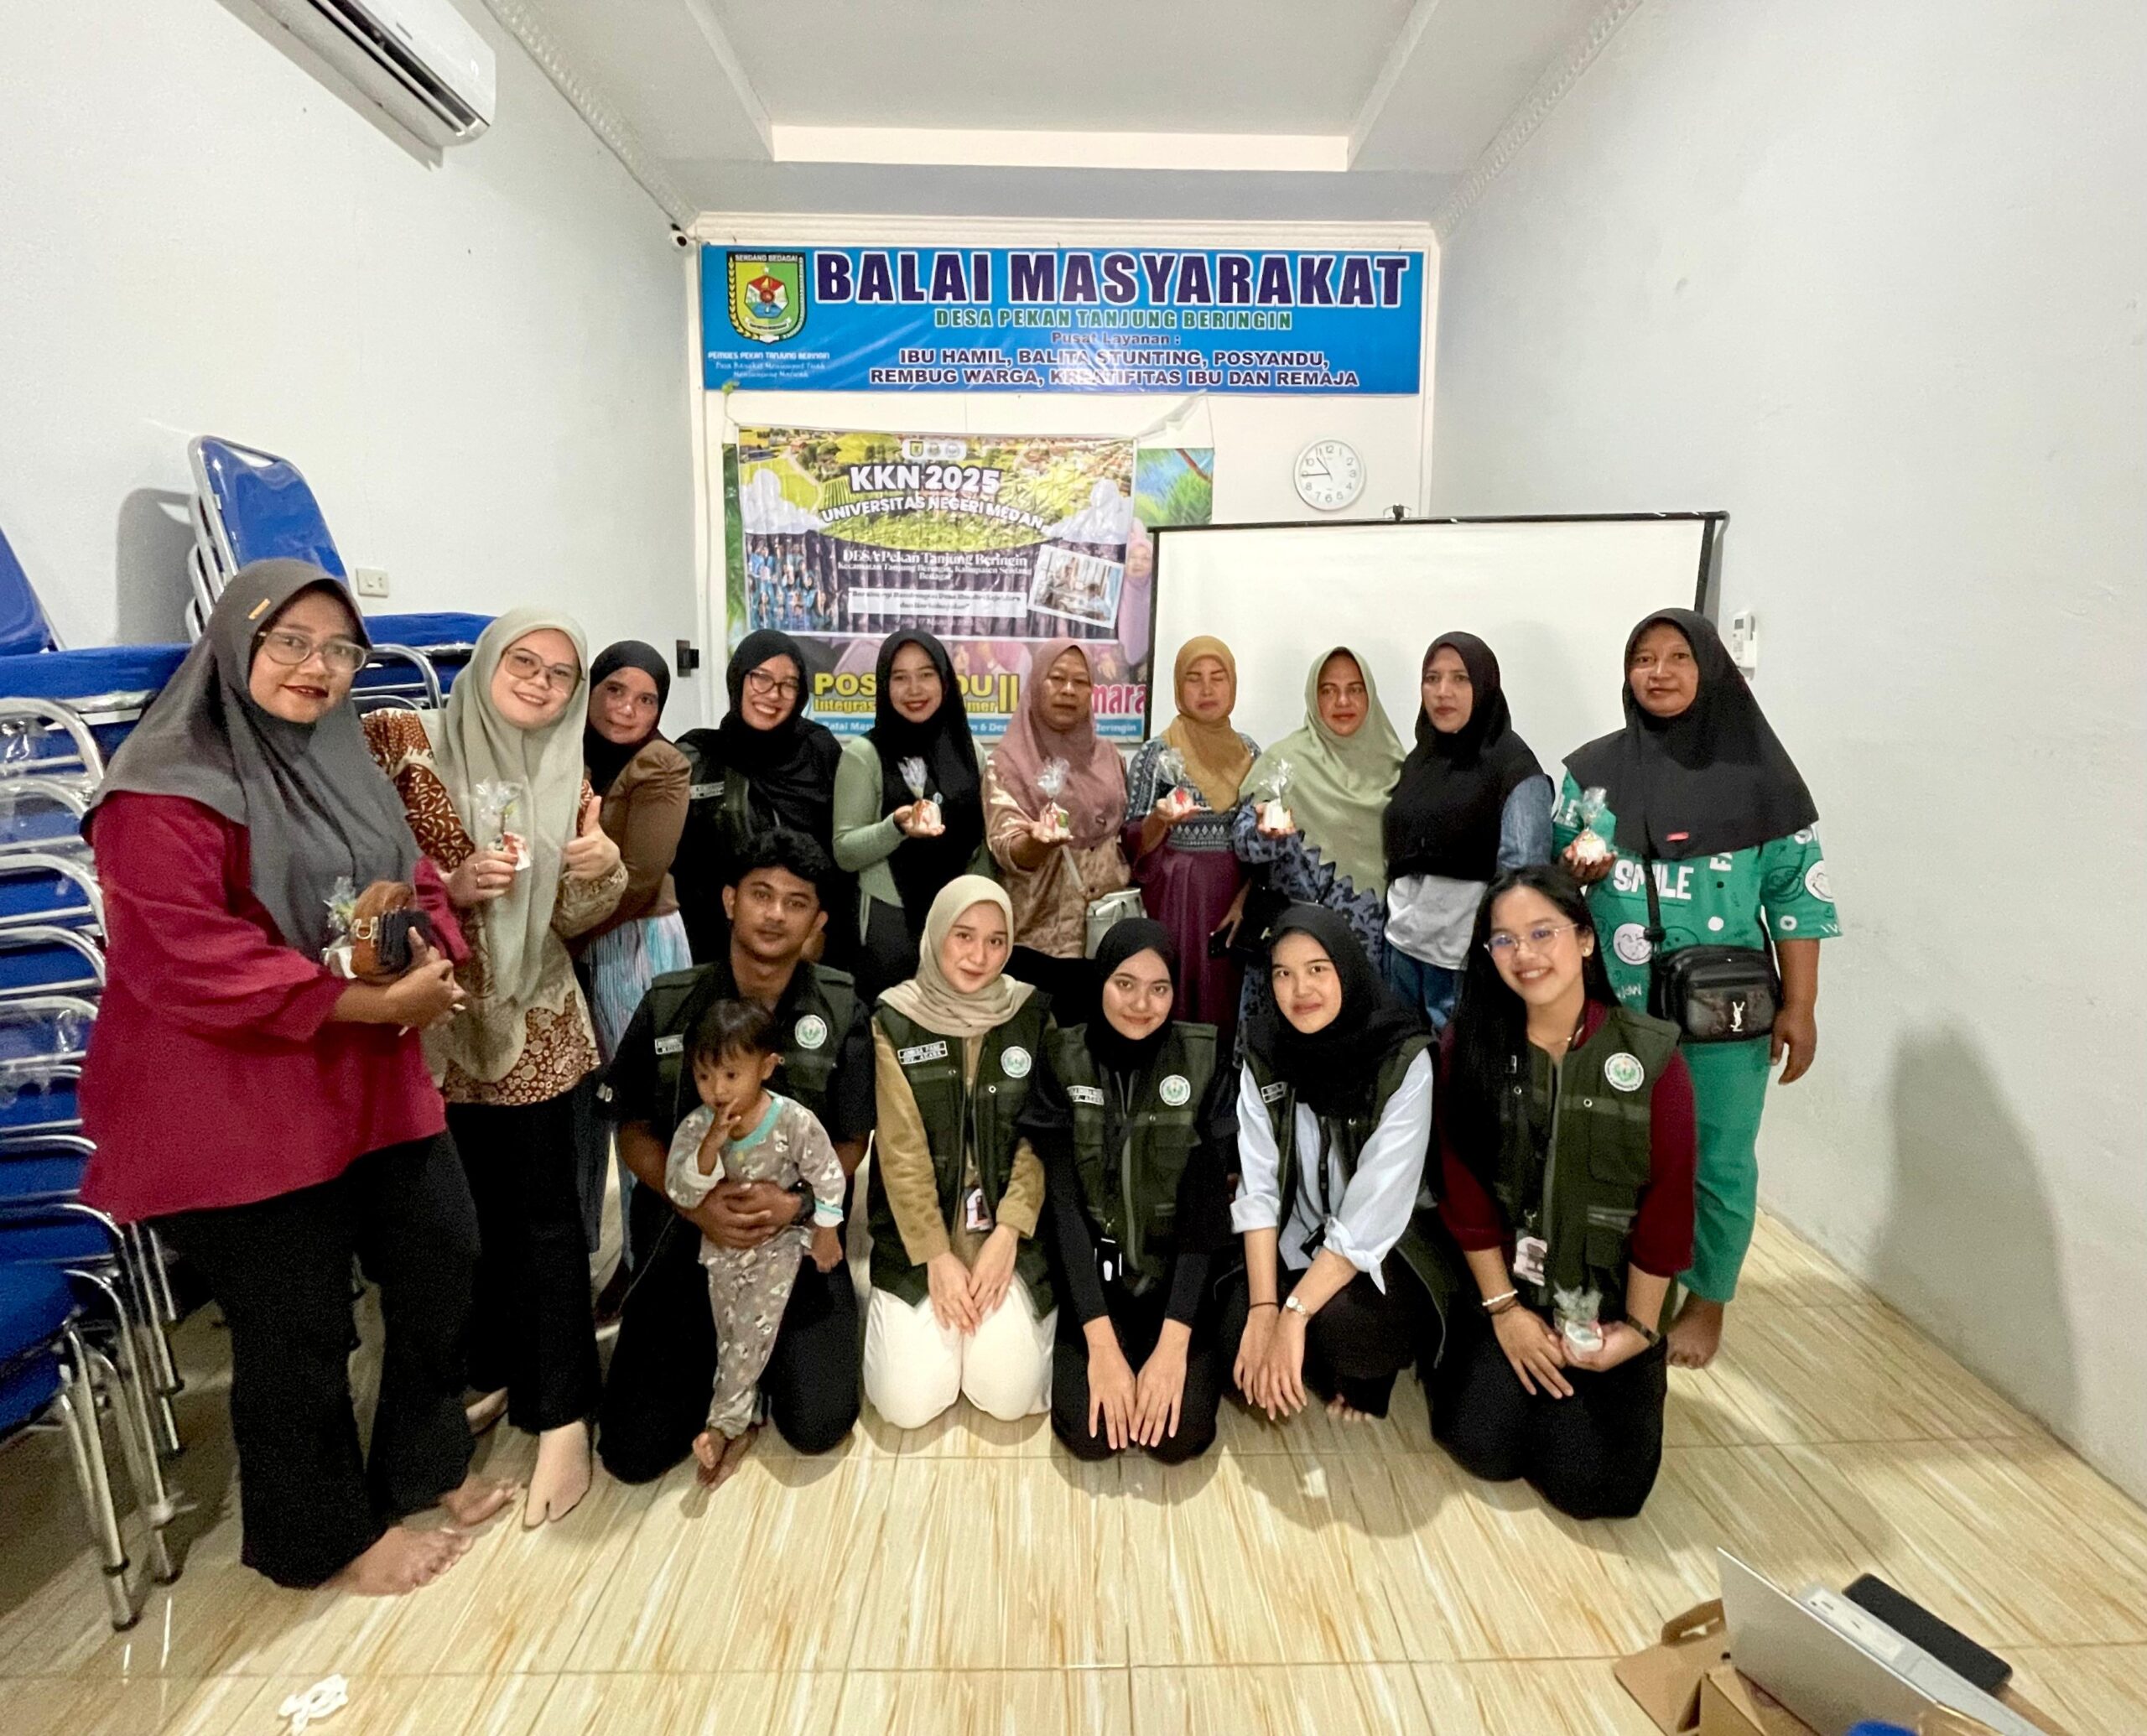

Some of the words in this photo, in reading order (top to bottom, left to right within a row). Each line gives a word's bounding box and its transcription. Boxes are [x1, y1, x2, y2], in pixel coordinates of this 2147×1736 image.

[816, 252, 990, 304] BALAI
[1009, 252, 1409, 307] MASYARAKAT
[935, 309, 992, 327] DESA
[998, 309, 1071, 328] PEKAN
[1077, 309, 1177, 329] TANJUNG
[1183, 310, 1292, 330] BERINGIN
[1052, 332, 1095, 344] Pusat
[1103, 333, 1170, 346] Layanan
[900, 349, 934, 364] IBU
[942, 349, 1011, 366] HAMIL,
[1018, 350, 1088, 365] BALITA
[1096, 350, 1208, 367] STUNTING,
[1214, 351, 1328, 367] POSYANDU,
[871, 369, 957, 383] REMBUG
[964, 369, 1044, 386] WARGA,
[1188, 371, 1221, 385] IBU
[1228, 371, 1270, 386] DAN
[1276, 372, 1359, 386] REMAJA
[850, 465, 920, 492] KKN
[925, 465, 1000, 494] 2025
[822, 496, 926, 522] UNIVERSITAS
[928, 496, 983, 513] NEGERI
[985, 503, 1043, 529] MEDAN
[881, 550, 920, 563] Pekan
[921, 552, 974, 567] Tanjung
[975, 553, 1027, 569] Beringin
[814, 698, 876, 714] Integras
